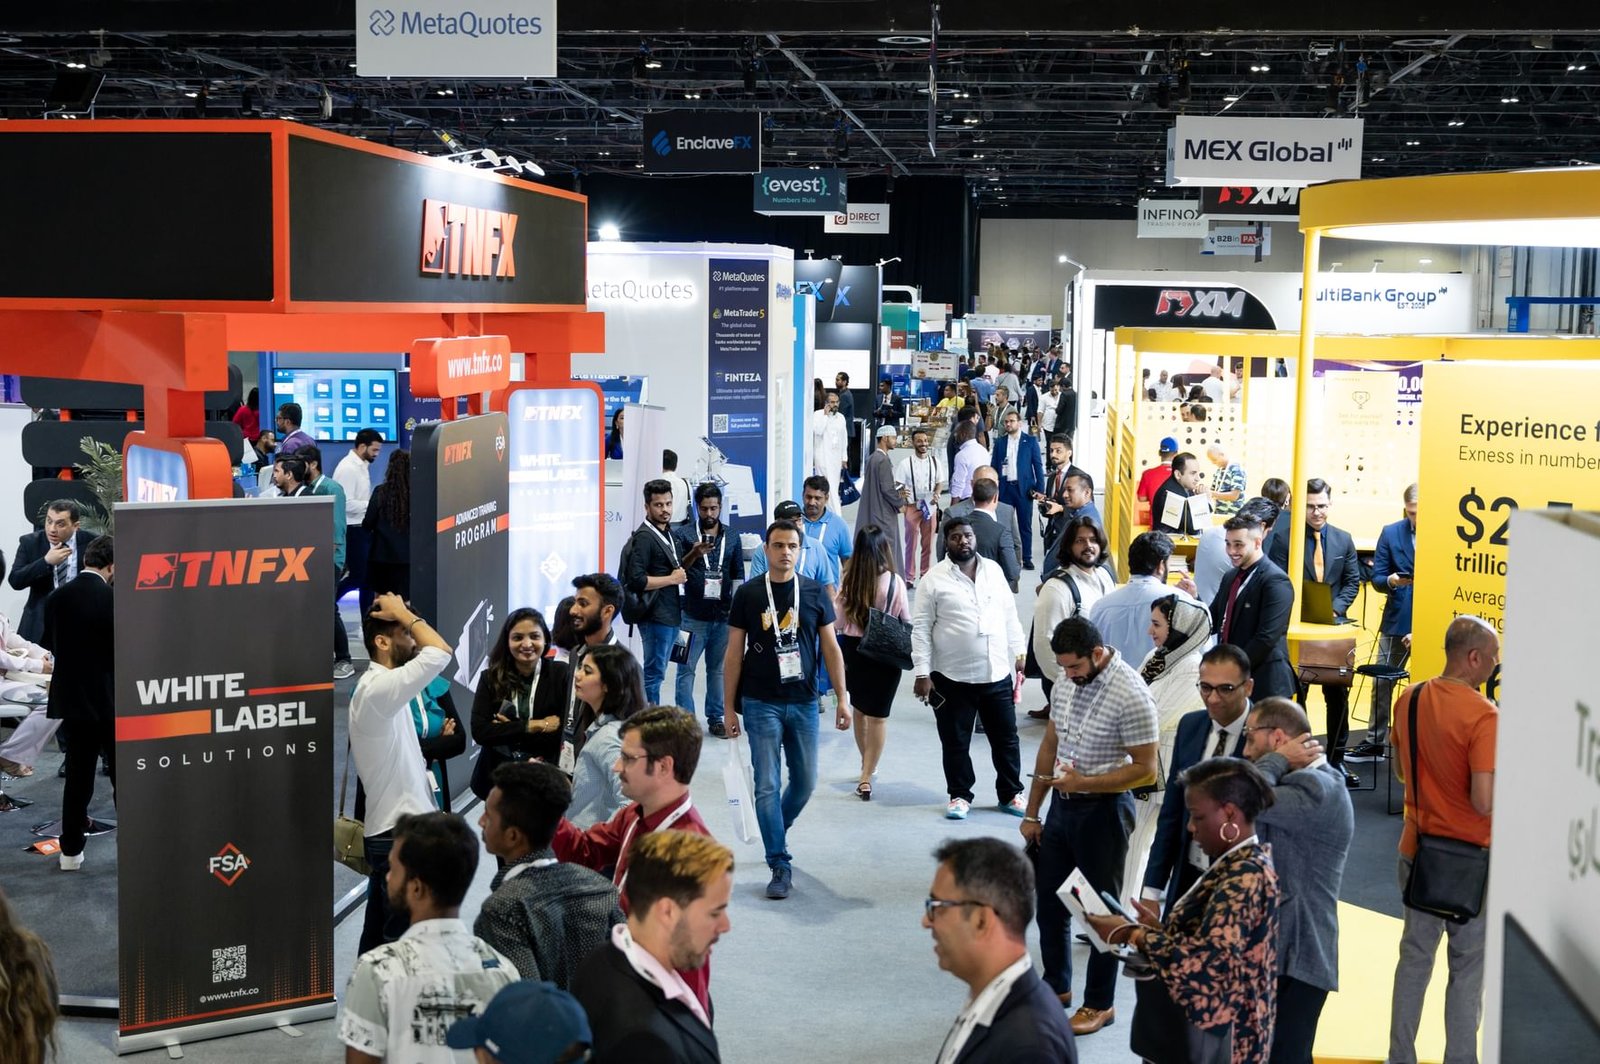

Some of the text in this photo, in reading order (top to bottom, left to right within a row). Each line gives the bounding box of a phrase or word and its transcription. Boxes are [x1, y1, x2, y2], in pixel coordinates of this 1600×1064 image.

[401, 11, 542, 38] MetaQuotes
[676, 136, 752, 150] EnclaveFX
[1184, 139, 1243, 161] MEX
[1248, 140, 1333, 163] Global
[849, 212, 880, 221] DIRECT
[447, 202, 519, 277] TNFX
[722, 271, 766, 282] MetaQuotes
[586, 280, 693, 302] etaQuotes
[1298, 287, 1437, 306] ultiBank Group
[723, 308, 766, 319] MetaTrader 5
[1190, 290, 1247, 318] XM
[447, 349, 503, 379] www.tnfx.co
[724, 373, 762, 383] FINTEZA
[1459, 413, 1587, 442] Experience
[1458, 445, 1515, 464] Exness
[1519, 449, 1534, 465] in
[455, 518, 497, 549] PROGRAM
[178, 546, 316, 588] TNFX
[1455, 553, 1508, 576] trillio
[1453, 586, 1507, 610] Averag
[136, 672, 245, 706] WHITE
[215, 701, 316, 733] LABEL
[136, 741, 317, 771] SOLUTIONS
[209, 854, 248, 874] FSA
[206, 986, 260, 1002] www.tnfx.co
